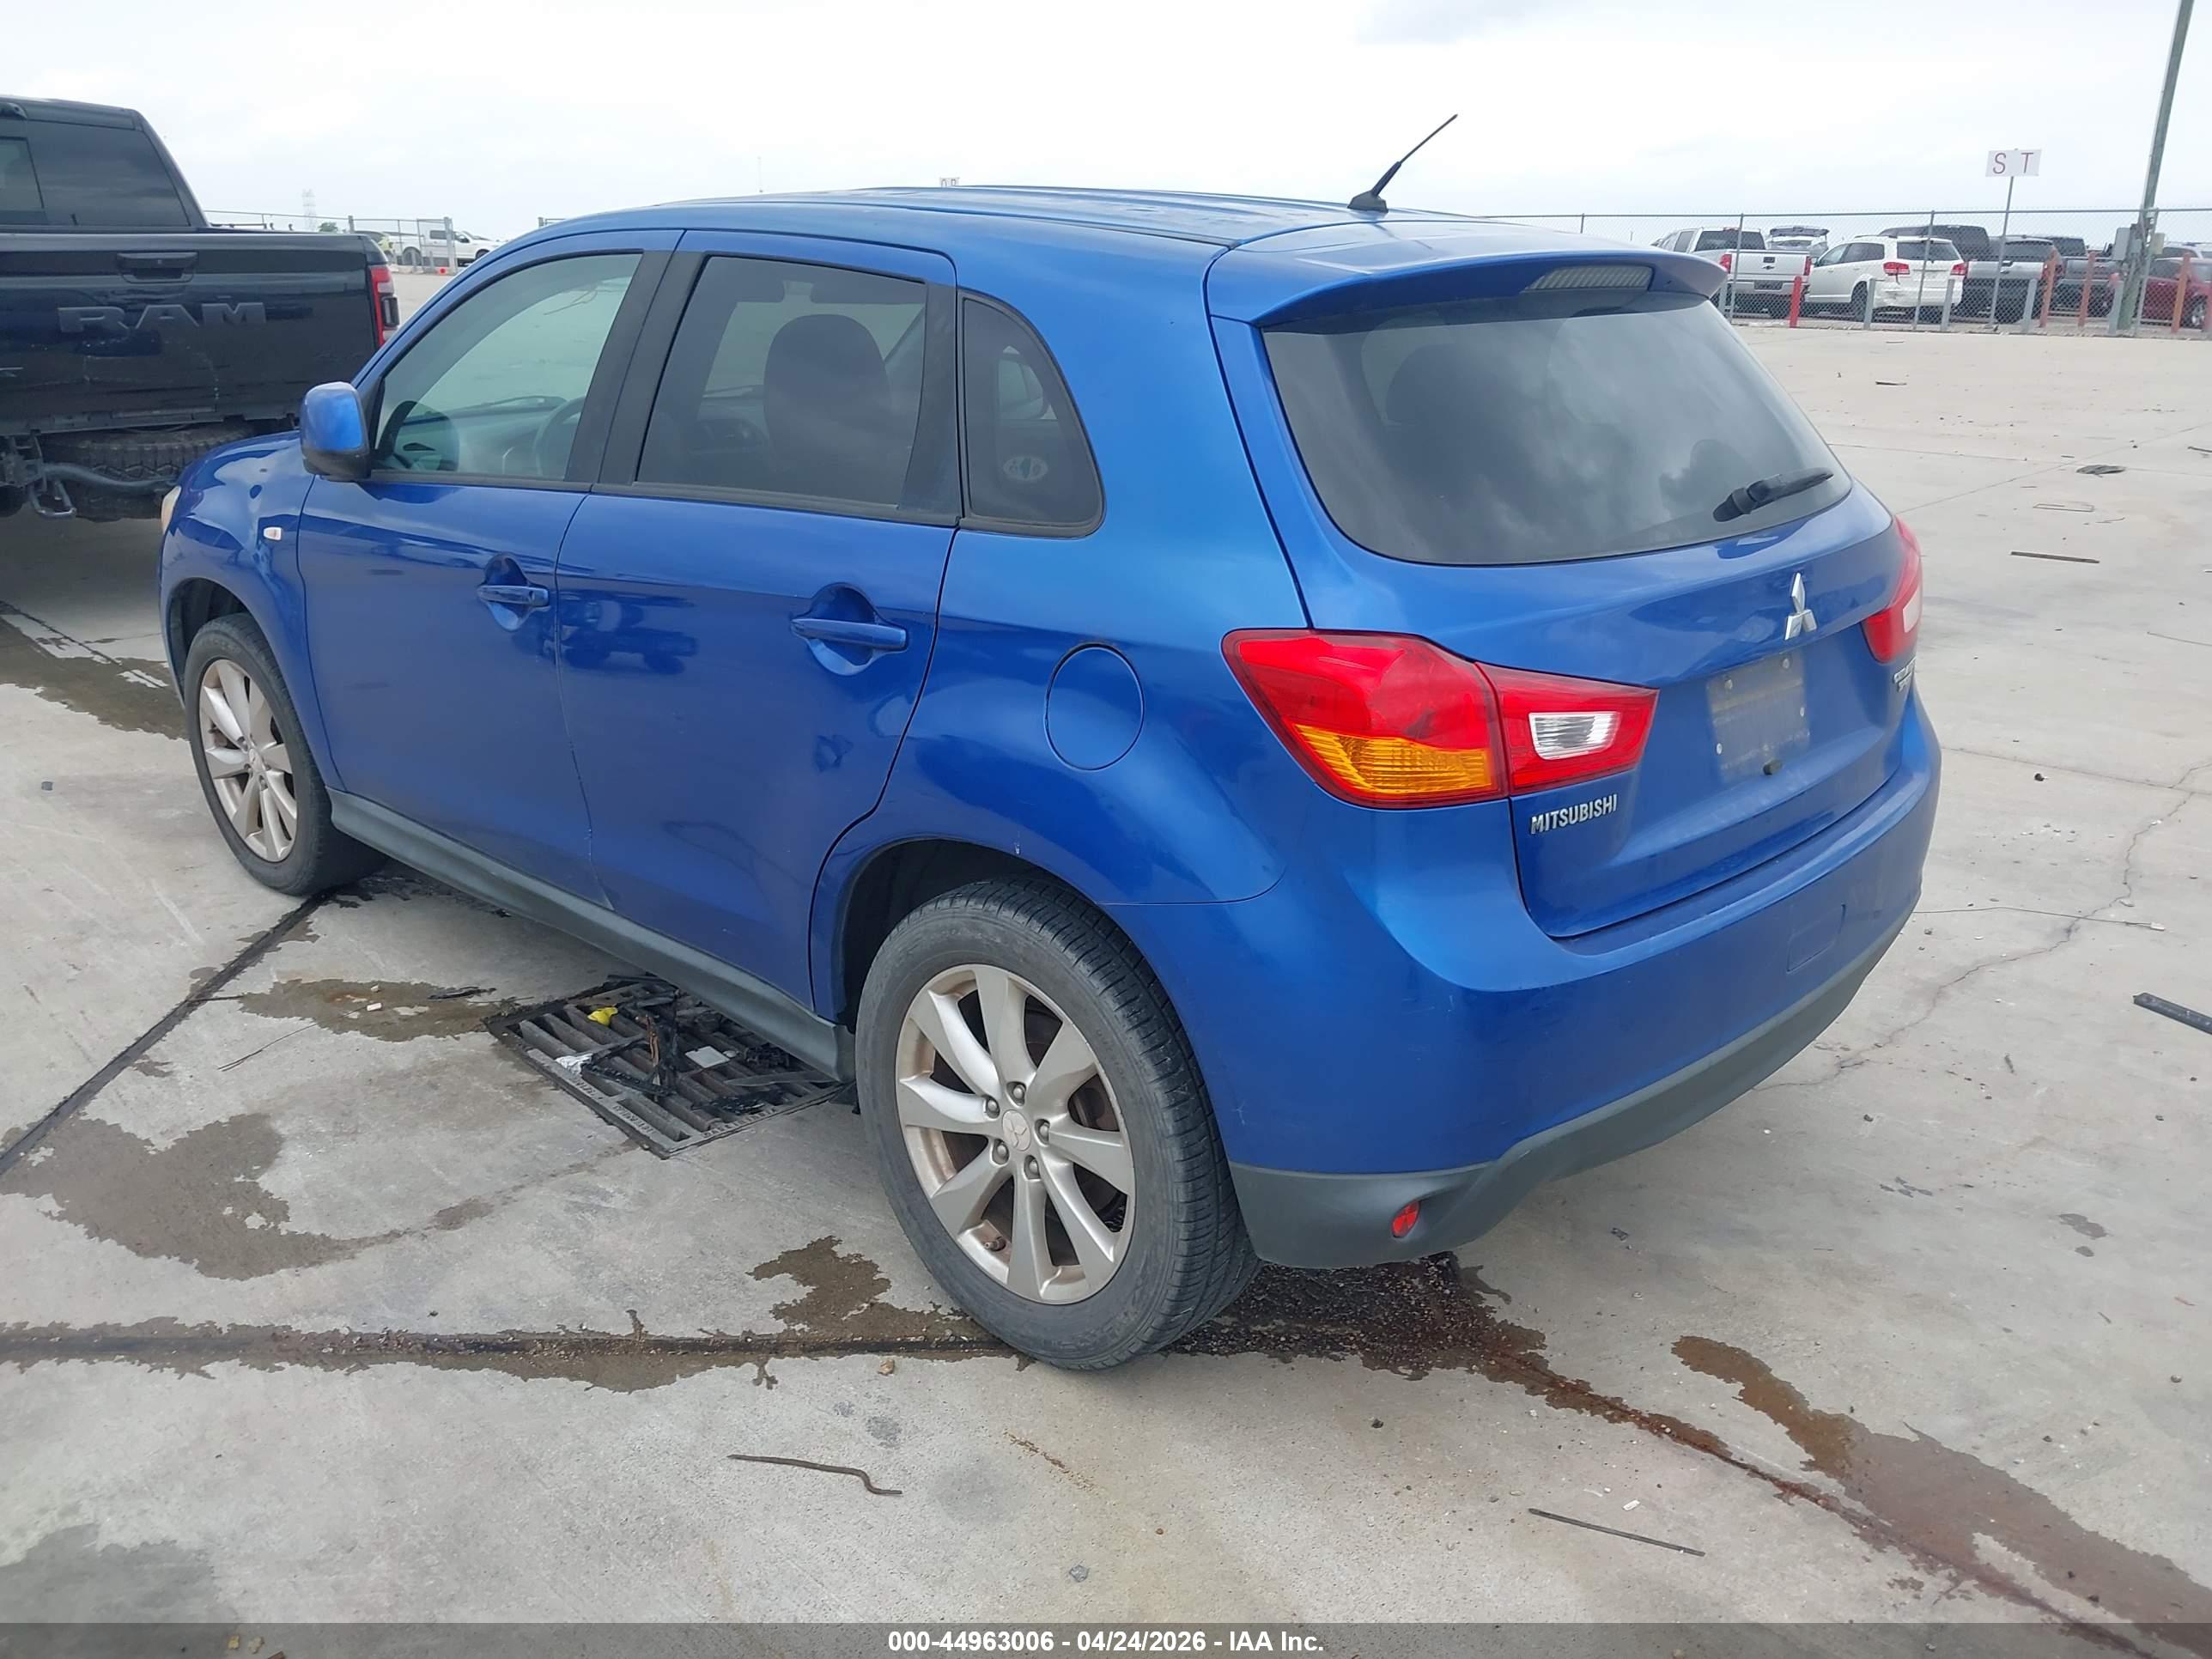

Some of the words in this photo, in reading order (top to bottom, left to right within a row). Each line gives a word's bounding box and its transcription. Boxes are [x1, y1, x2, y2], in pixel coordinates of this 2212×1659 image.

[1992, 152, 2007, 174] S
[2021, 152, 2034, 173] T
[58, 302, 266, 333] RAM
[1530, 793, 1619, 836] MITSUBISHI
